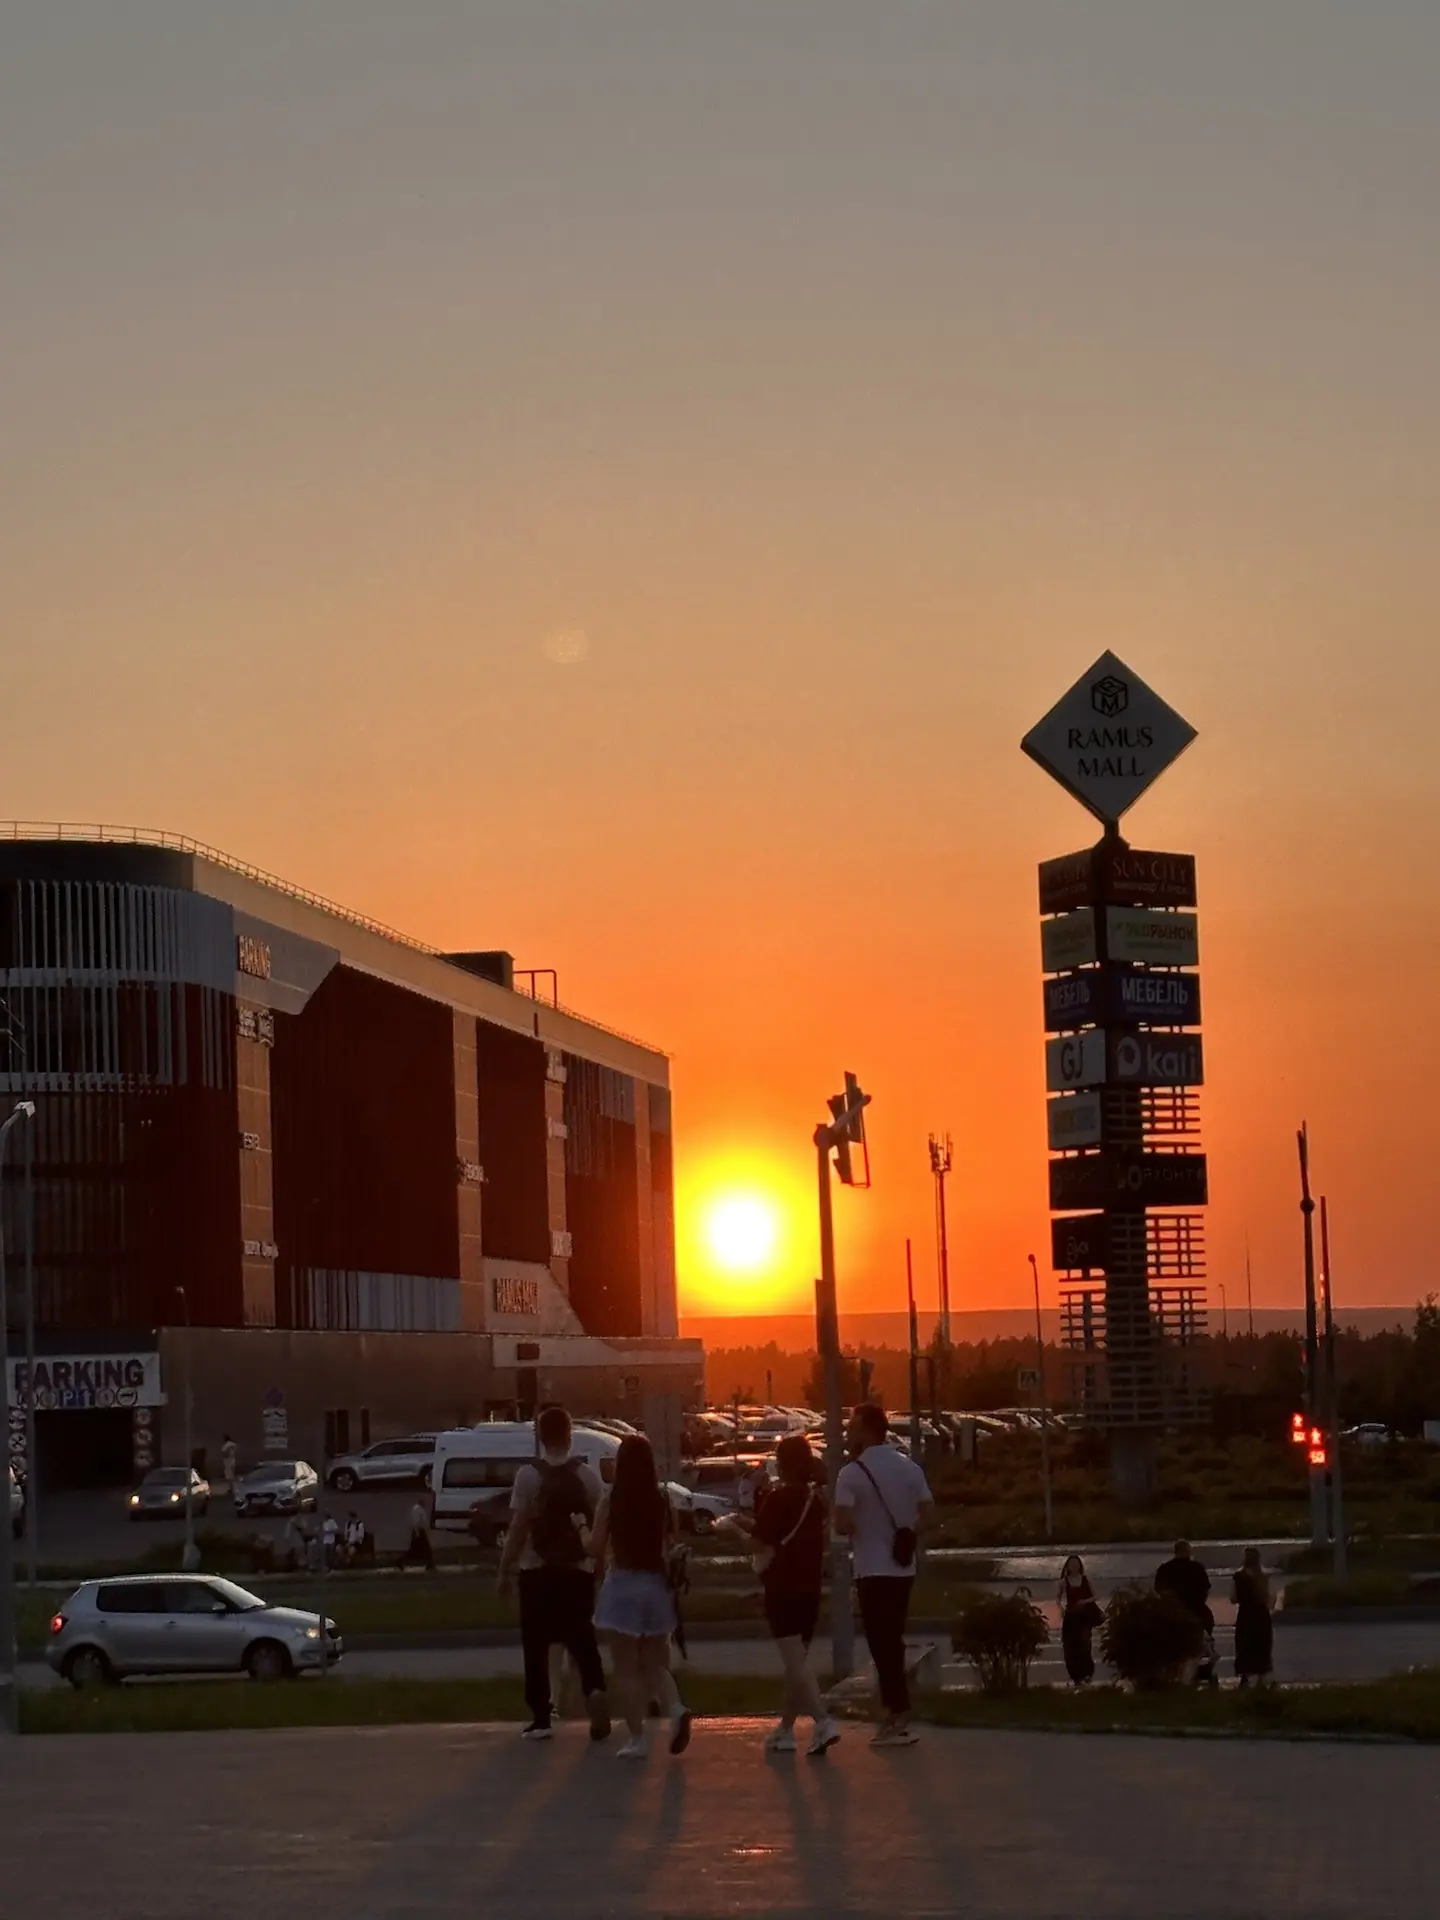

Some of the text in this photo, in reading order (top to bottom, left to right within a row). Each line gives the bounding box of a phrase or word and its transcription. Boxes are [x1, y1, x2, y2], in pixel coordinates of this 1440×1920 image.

[1067, 726, 1154, 750] RAMUS
[1077, 756, 1146, 778] MALL
[1121, 977, 1189, 1005] МЕБЕЛЬ
[1146, 1041, 1197, 1080] kari
[14, 1358, 144, 1391] PARKING
